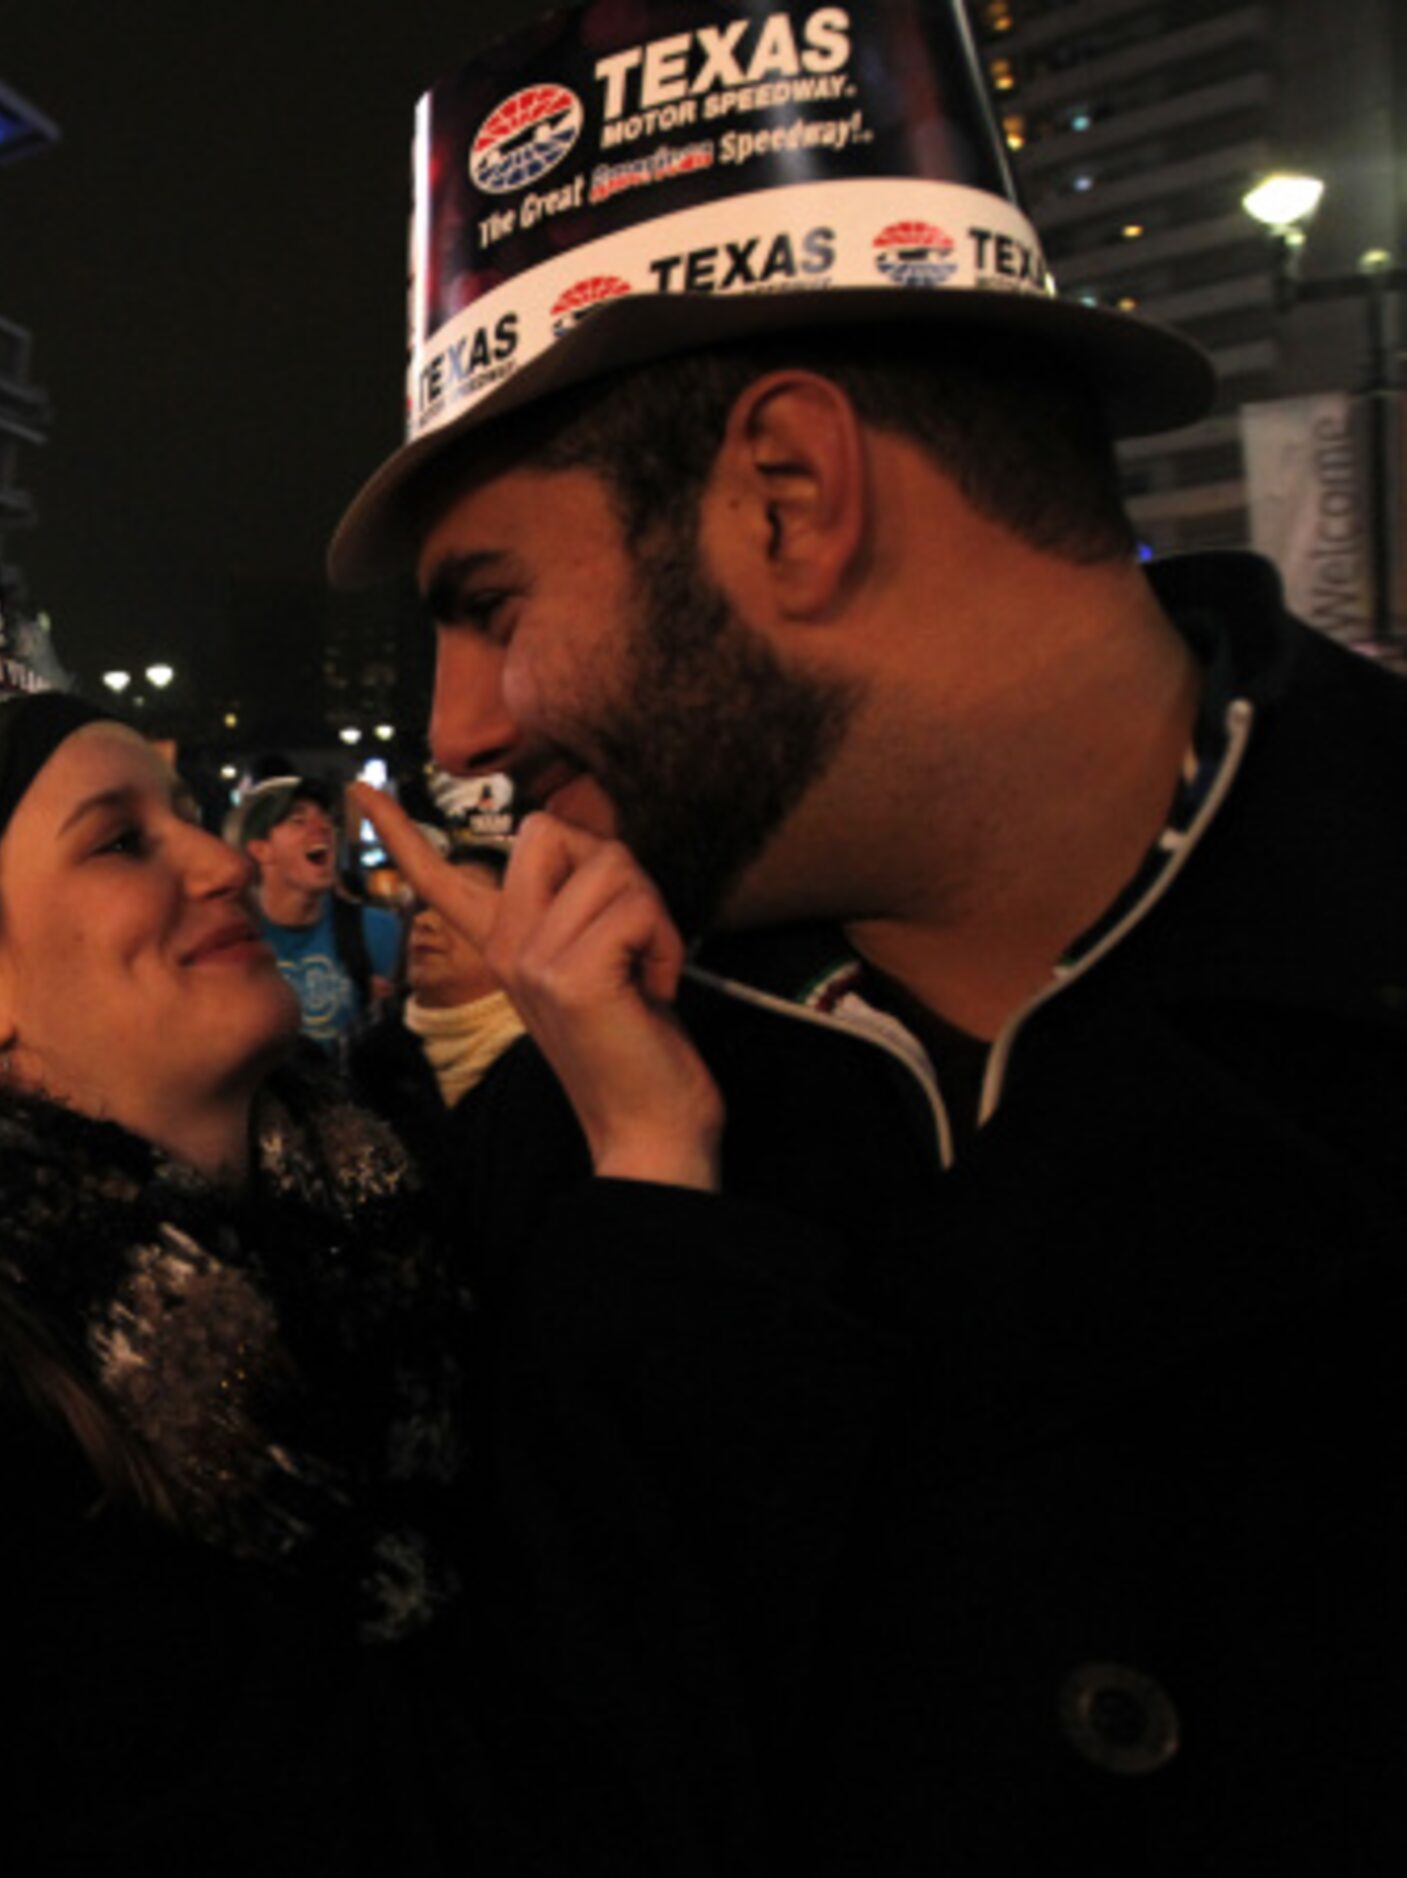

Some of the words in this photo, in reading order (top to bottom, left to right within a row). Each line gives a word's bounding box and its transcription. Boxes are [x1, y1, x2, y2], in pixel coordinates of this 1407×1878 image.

[595, 7, 850, 120] TEXAS
[601, 102, 698, 149] MOTOR
[478, 206, 517, 248] The
[520, 175, 585, 229] Great
[650, 227, 836, 293] TEXAS
[419, 313, 519, 412] TEXAS
[1311, 416, 1363, 634] Welcome
